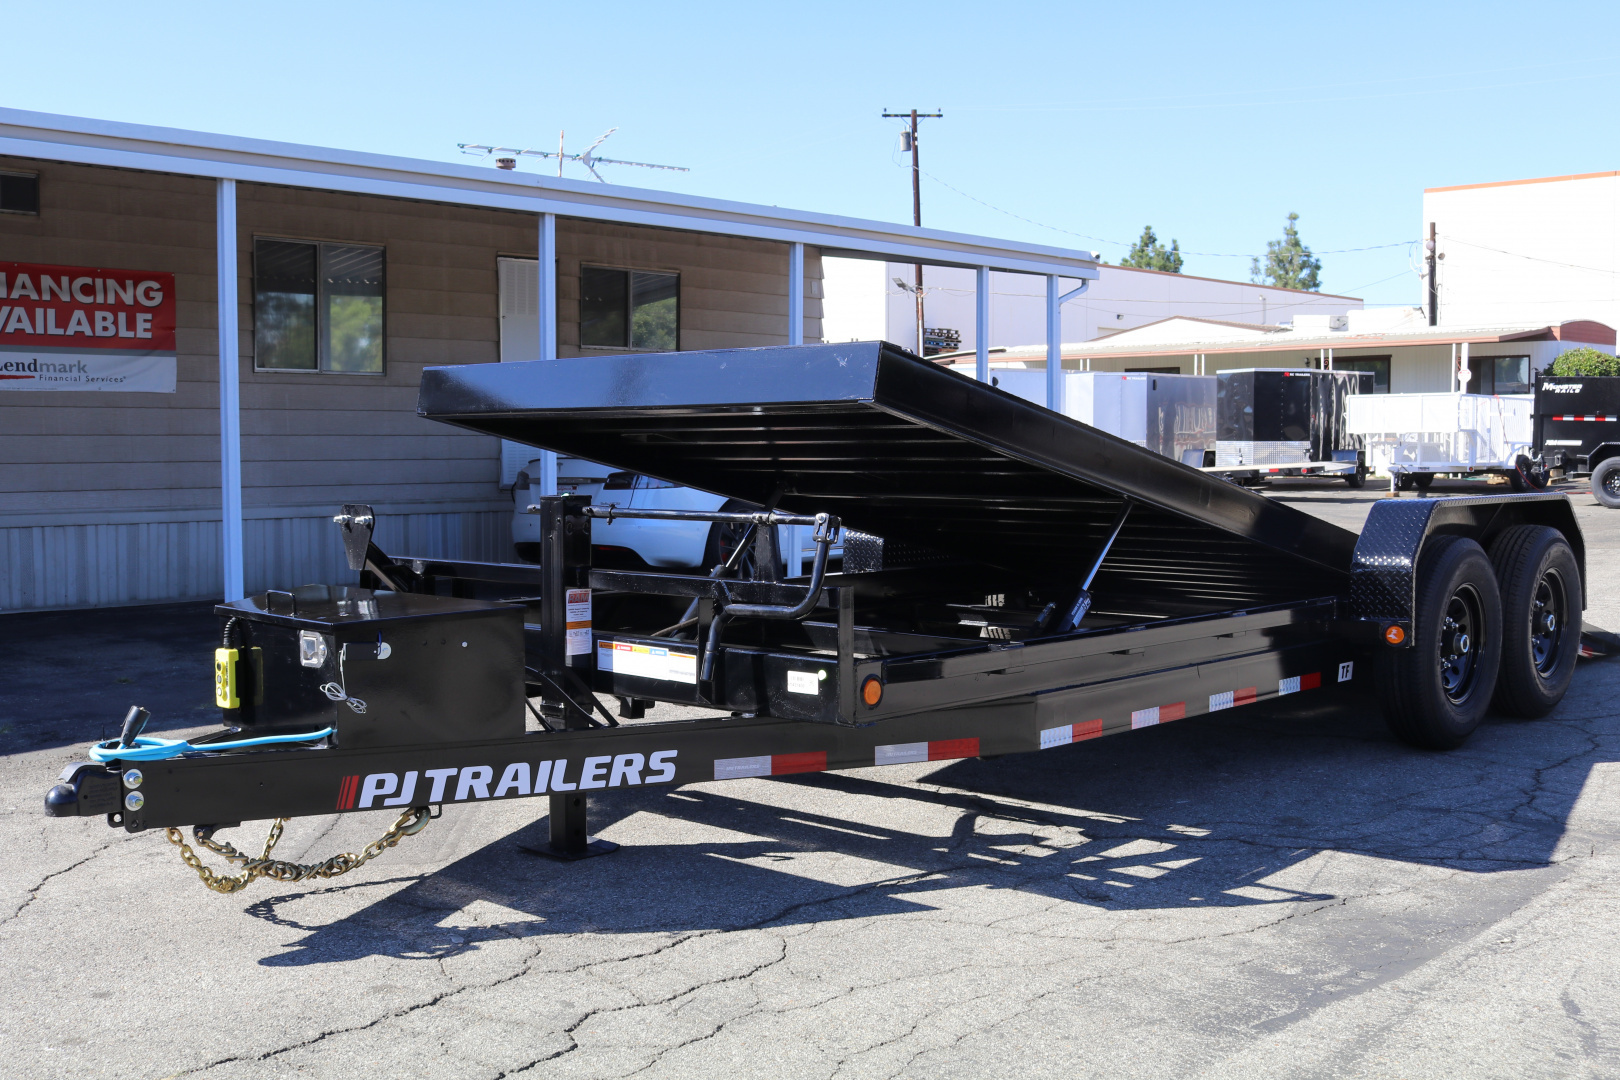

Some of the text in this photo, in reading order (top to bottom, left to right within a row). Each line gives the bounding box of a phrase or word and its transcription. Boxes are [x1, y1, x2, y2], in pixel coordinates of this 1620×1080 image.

[0, 272, 164, 307] ANCING
[0, 358, 88, 374] endmark
[39, 374, 81, 383] Financial
[1542, 382, 1583, 391] MONSTER
[1341, 665, 1350, 679] TF
[424, 749, 678, 802] TRAILERS
